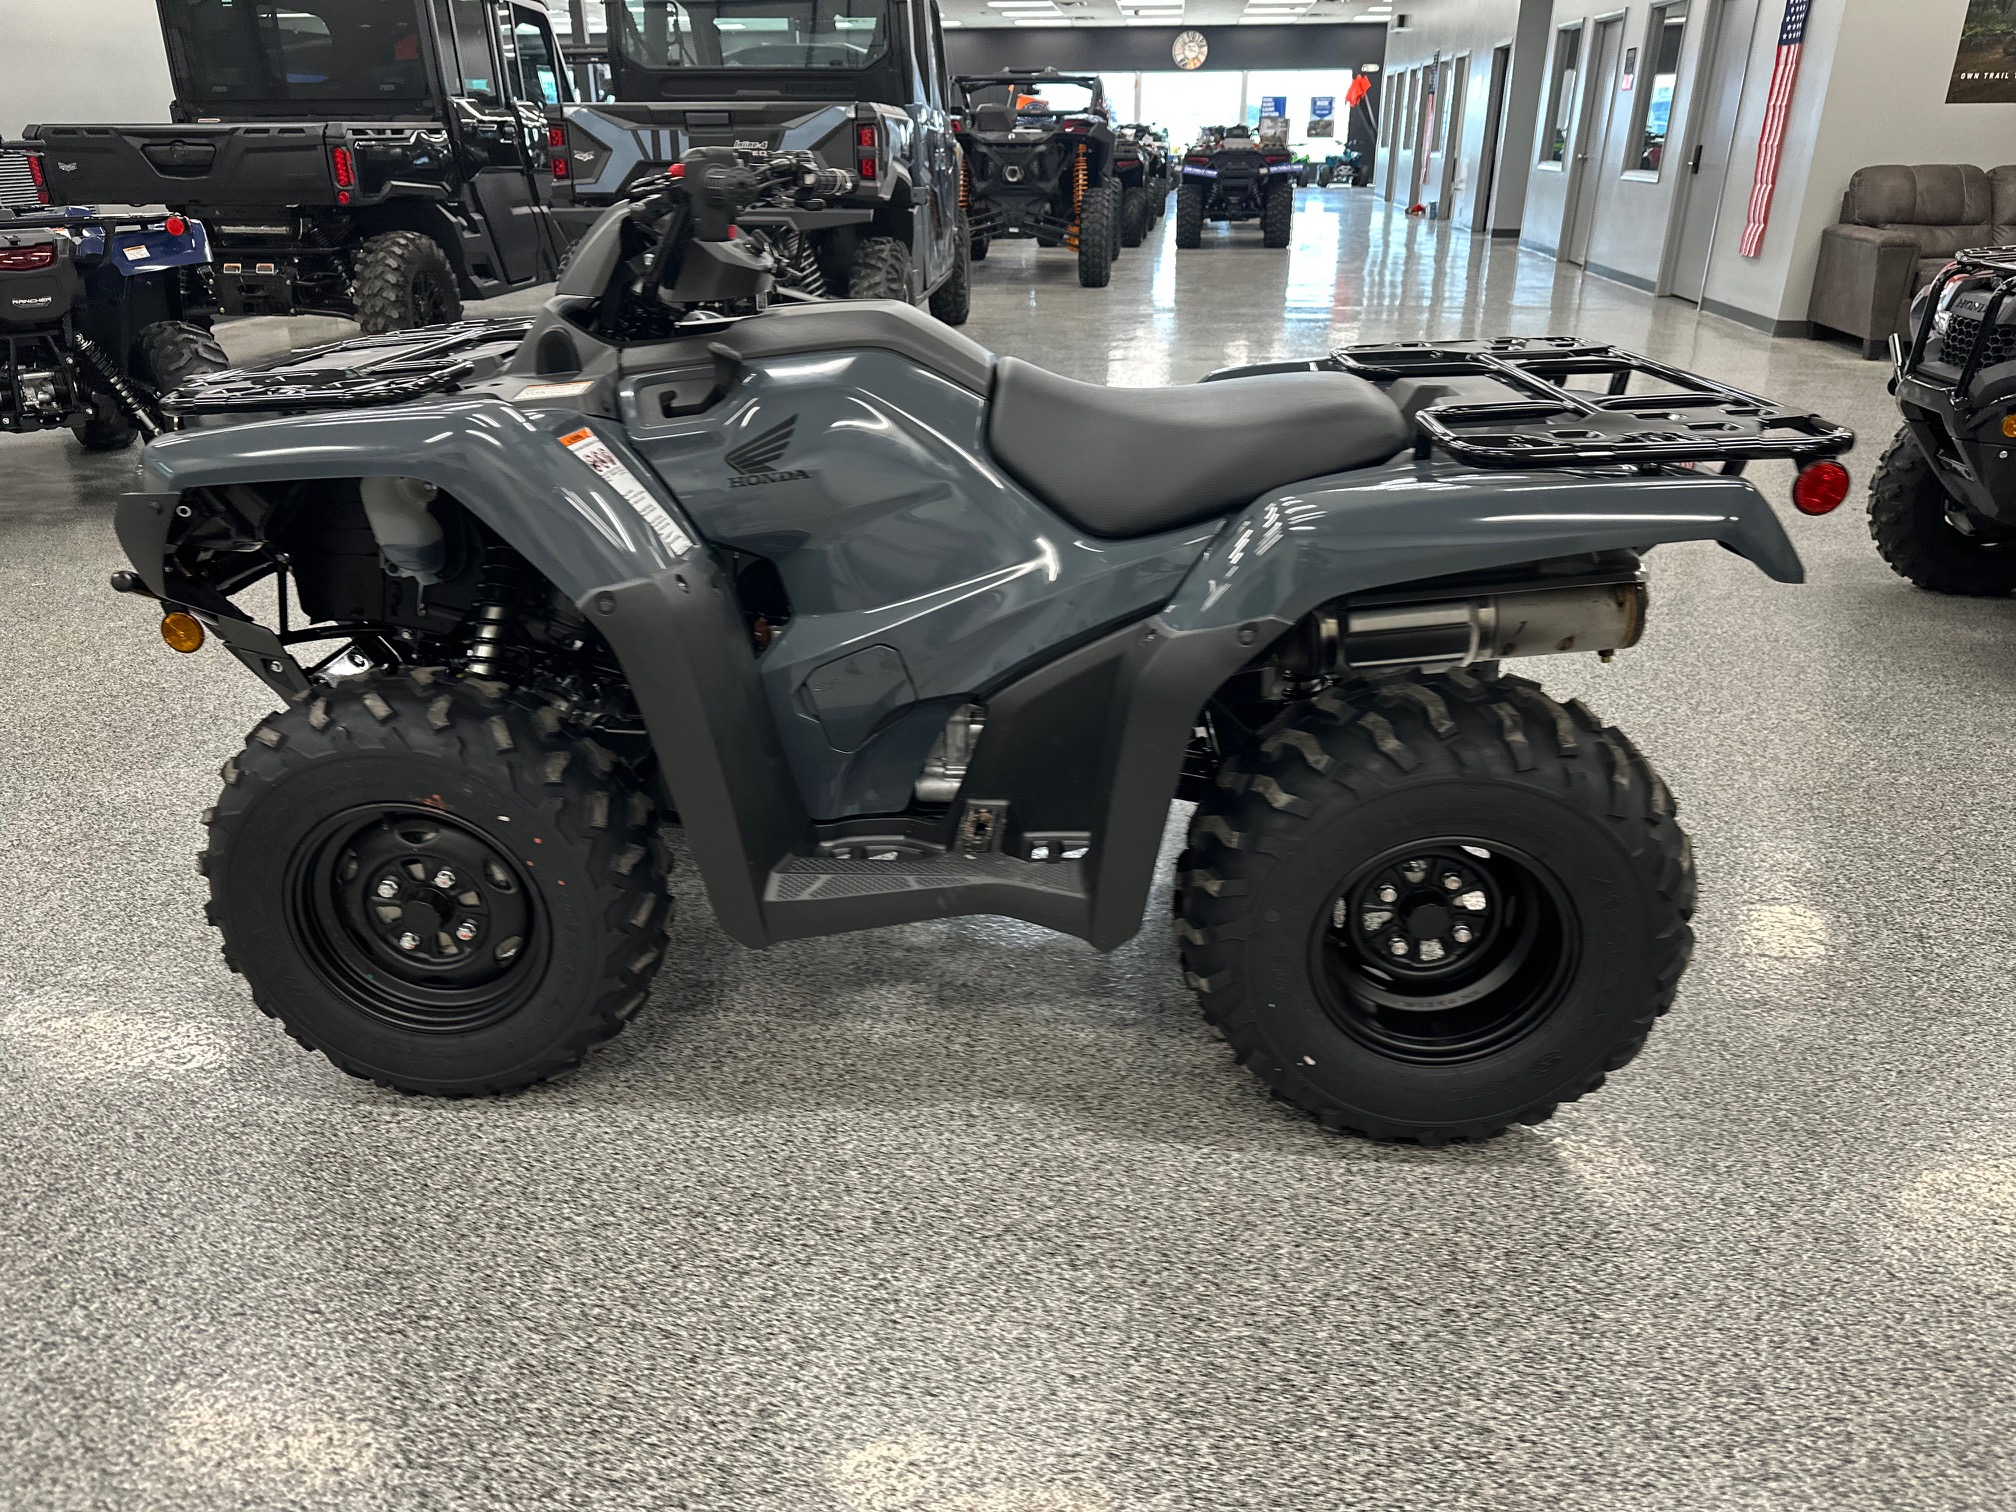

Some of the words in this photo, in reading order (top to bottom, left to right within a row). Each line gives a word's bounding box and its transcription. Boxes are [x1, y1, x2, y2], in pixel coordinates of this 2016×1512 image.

[1960, 72, 1980, 80] OWN
[1983, 72, 2009, 80] TRAIL
[727, 469, 812, 488] HONDA
